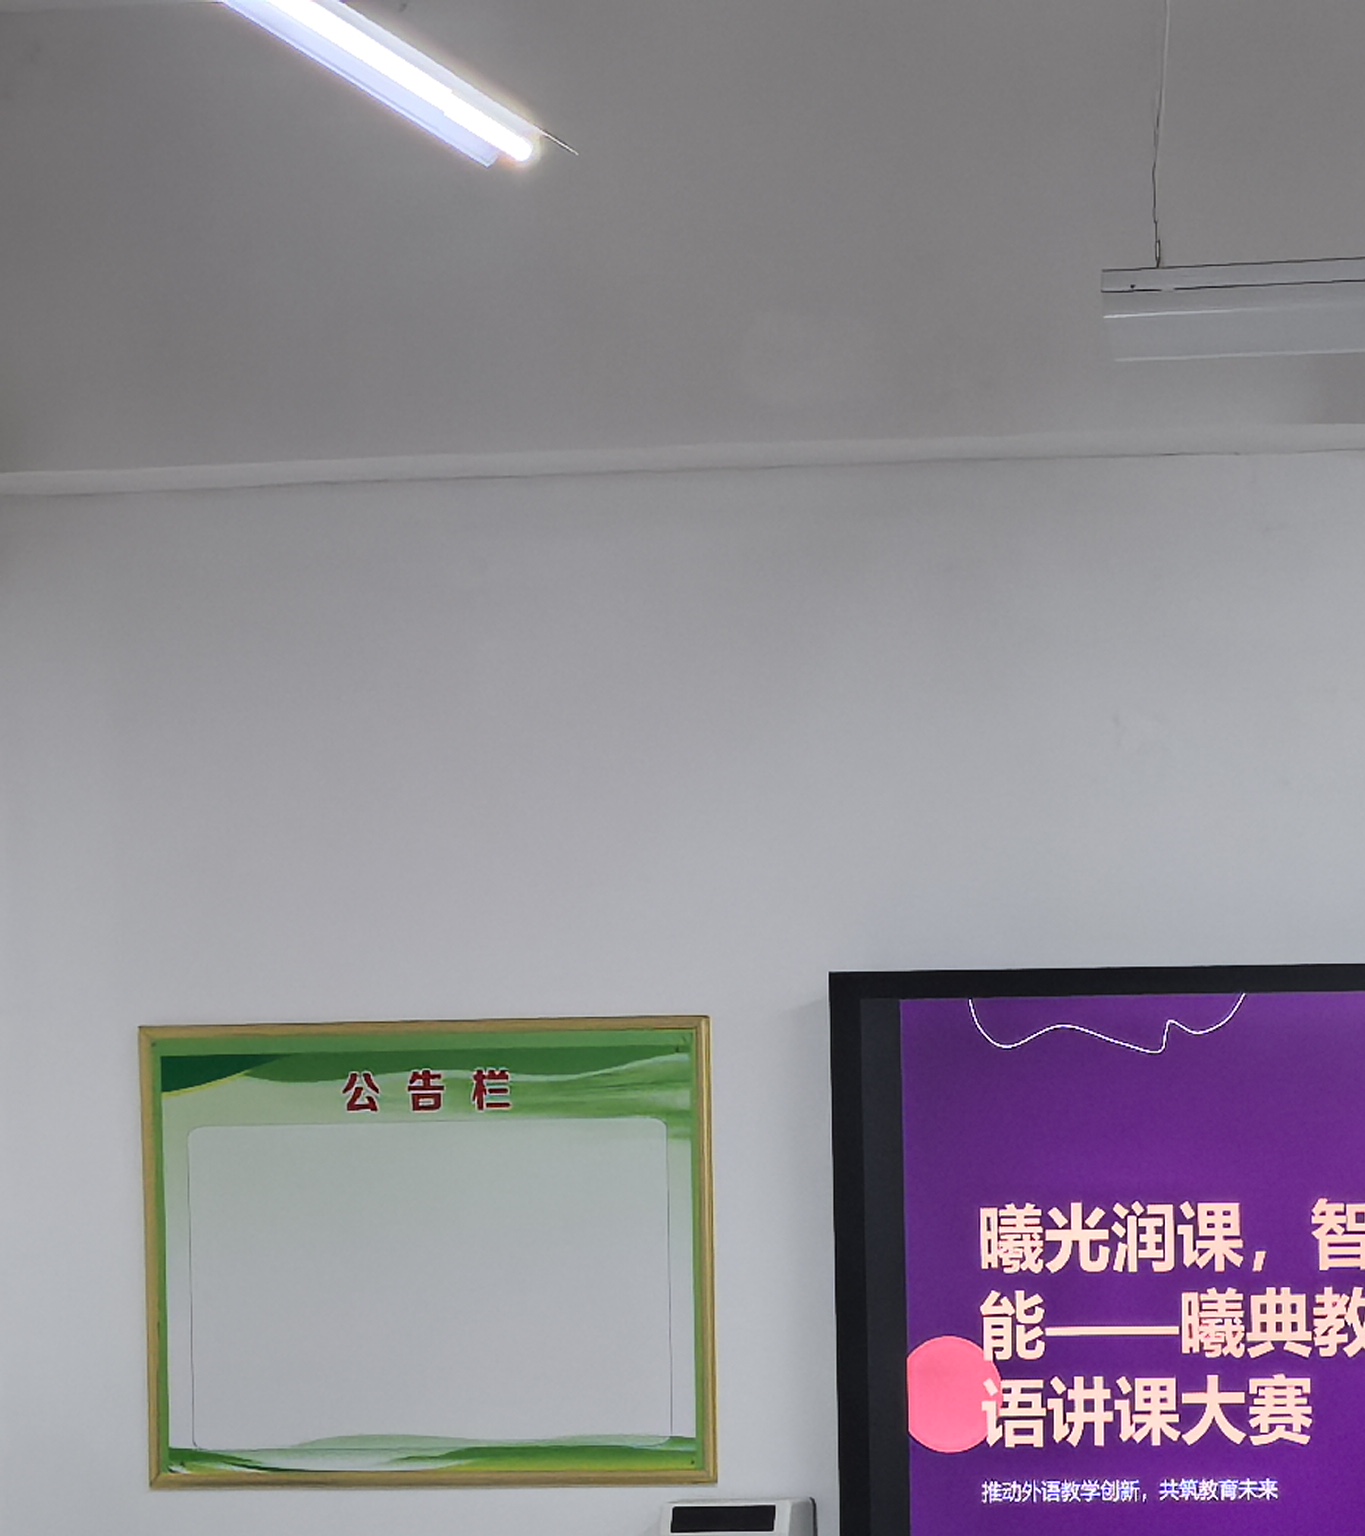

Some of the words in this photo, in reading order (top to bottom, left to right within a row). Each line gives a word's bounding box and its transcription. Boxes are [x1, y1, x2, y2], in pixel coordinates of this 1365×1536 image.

[342, 1067, 511, 1112] 公告栏
[980, 1373, 1313, 1448] 语讲课大赛
[980, 1478, 1280, 1504] 推动外语教学创新，共筑教育未来
